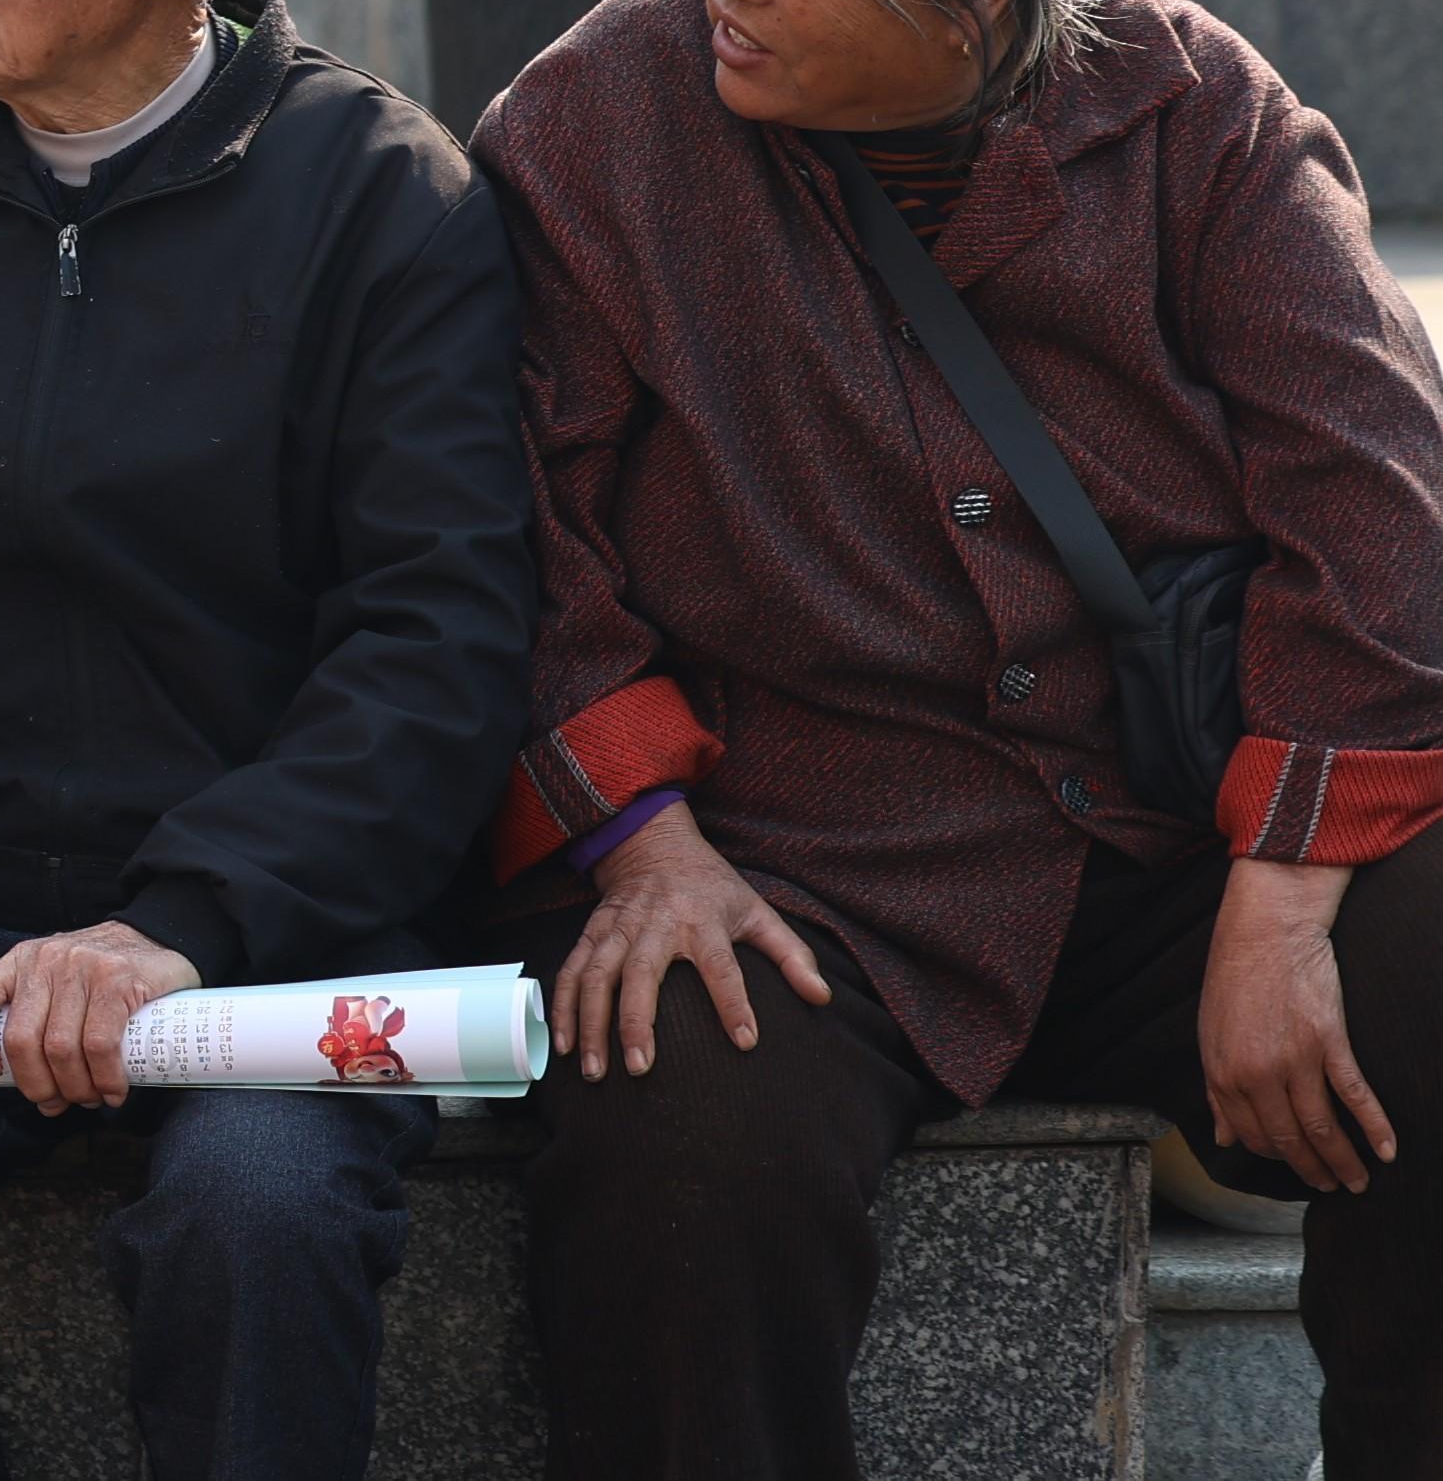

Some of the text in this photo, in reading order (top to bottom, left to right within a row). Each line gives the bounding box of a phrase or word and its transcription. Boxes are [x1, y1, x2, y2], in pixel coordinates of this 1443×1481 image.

[128, 1023, 232, 1036] 20 21 22 23 24
[129, 1044, 233, 1056] 13 14 15 16 17
[180, 1064, 187, 1072] 8
[225, 1063, 233, 1071] 6
